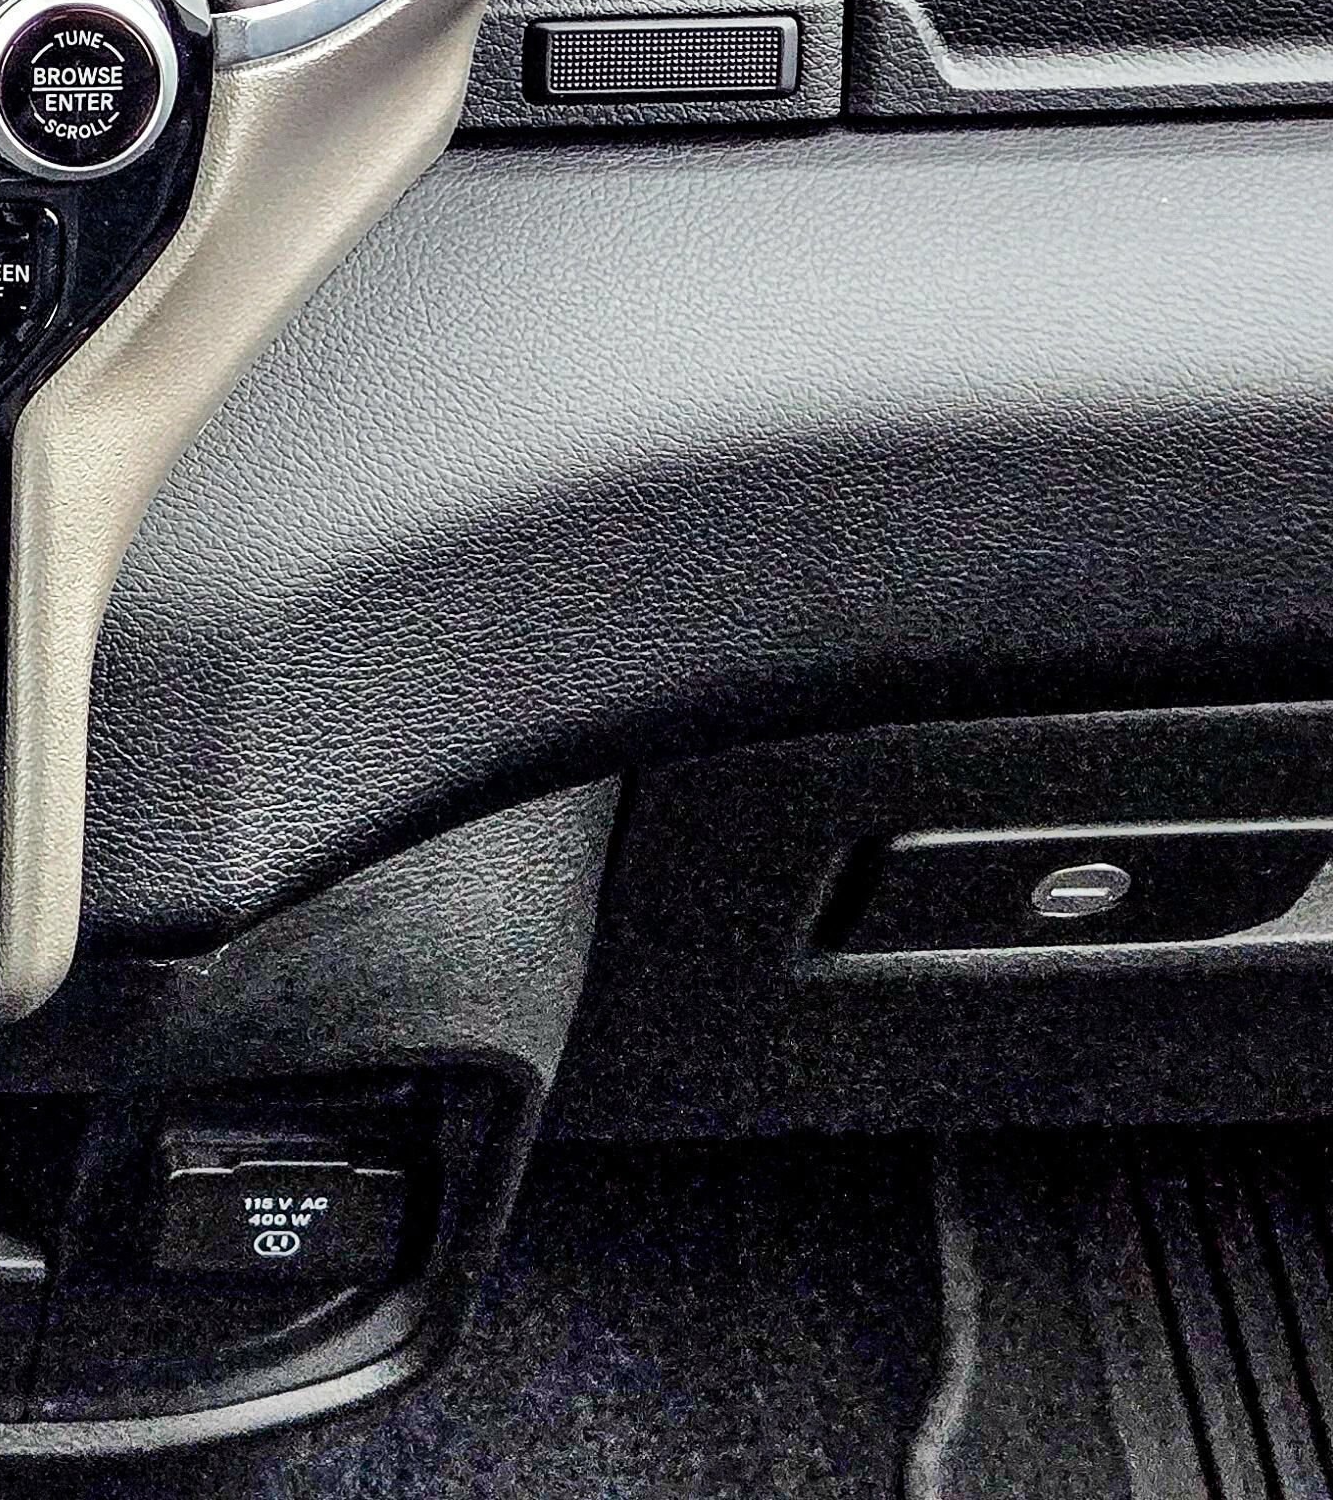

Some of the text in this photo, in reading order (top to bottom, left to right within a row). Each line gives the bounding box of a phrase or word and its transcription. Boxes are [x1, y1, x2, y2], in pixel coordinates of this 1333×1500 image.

[54, 30, 104, 50] TUNE
[34, 66, 123, 86] BROWSE
[45, 93, 114, 112] ENTER
[43, 119, 112, 139] SCROLL
[244, 1197, 329, 1210] 115 V AC
[248, 1213, 312, 1226] 400 W
